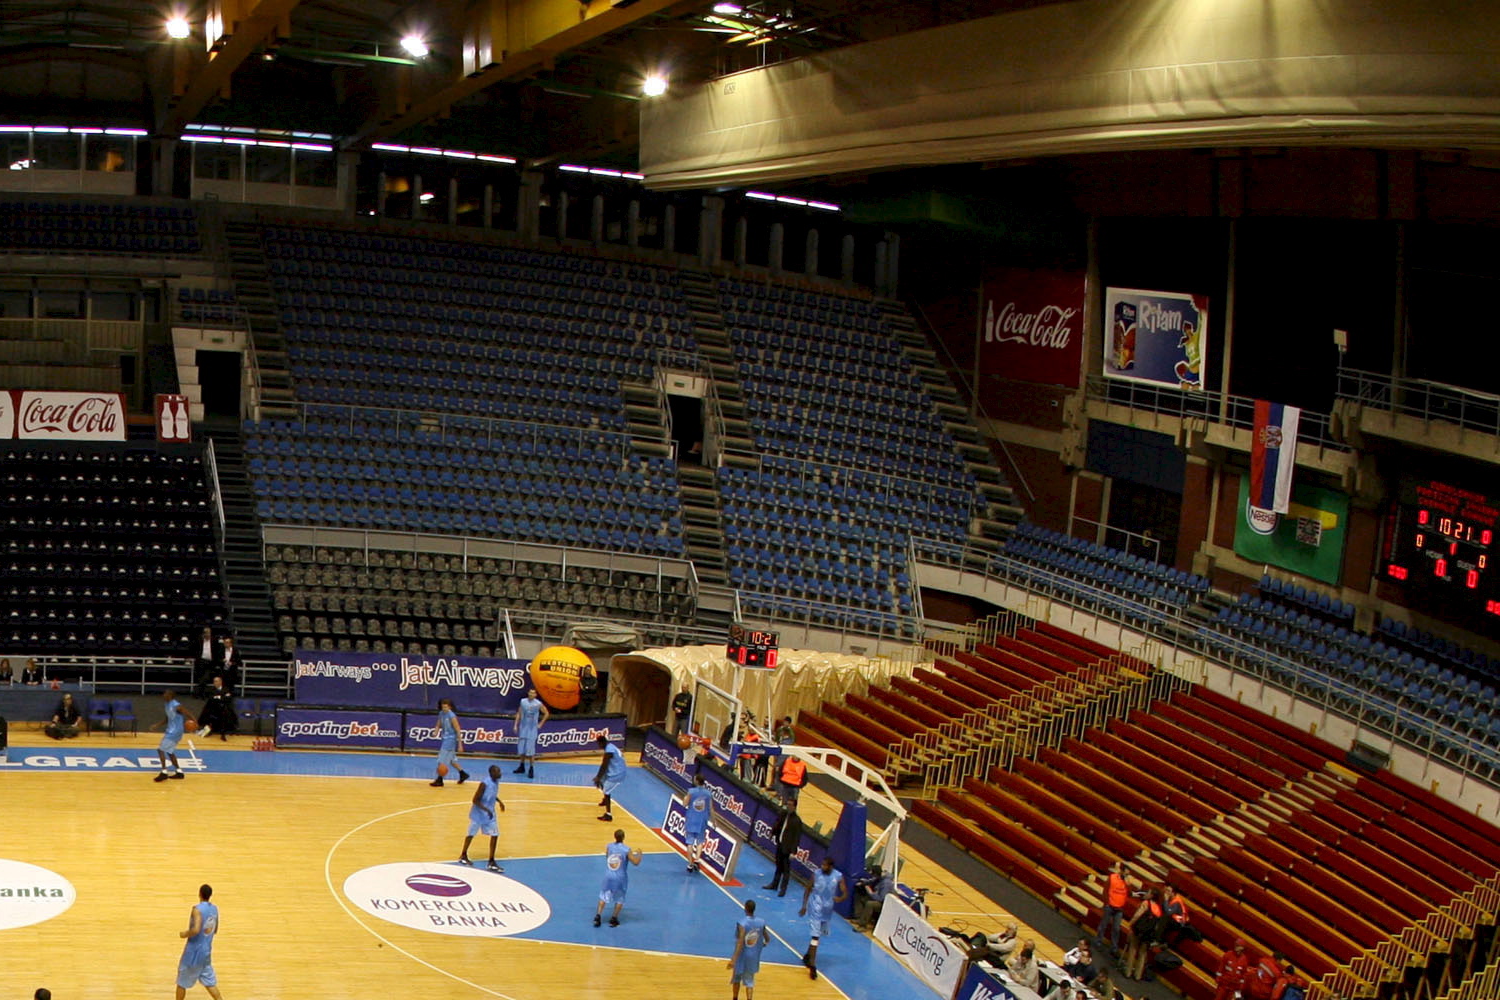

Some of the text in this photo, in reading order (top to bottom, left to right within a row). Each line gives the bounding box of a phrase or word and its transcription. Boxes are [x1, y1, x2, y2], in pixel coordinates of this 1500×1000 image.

[995, 302, 1077, 349] Coca-Cola
[1138, 301, 1182, 333] Ritam
[22, 398, 117, 433] Coca-Cola
[752, 631, 779, 645] 10:21
[280, 720, 397, 740] sportingbet.com
[370, 899, 534, 914] KOMERCIJALNA
[429, 915, 507, 928] BANKA
